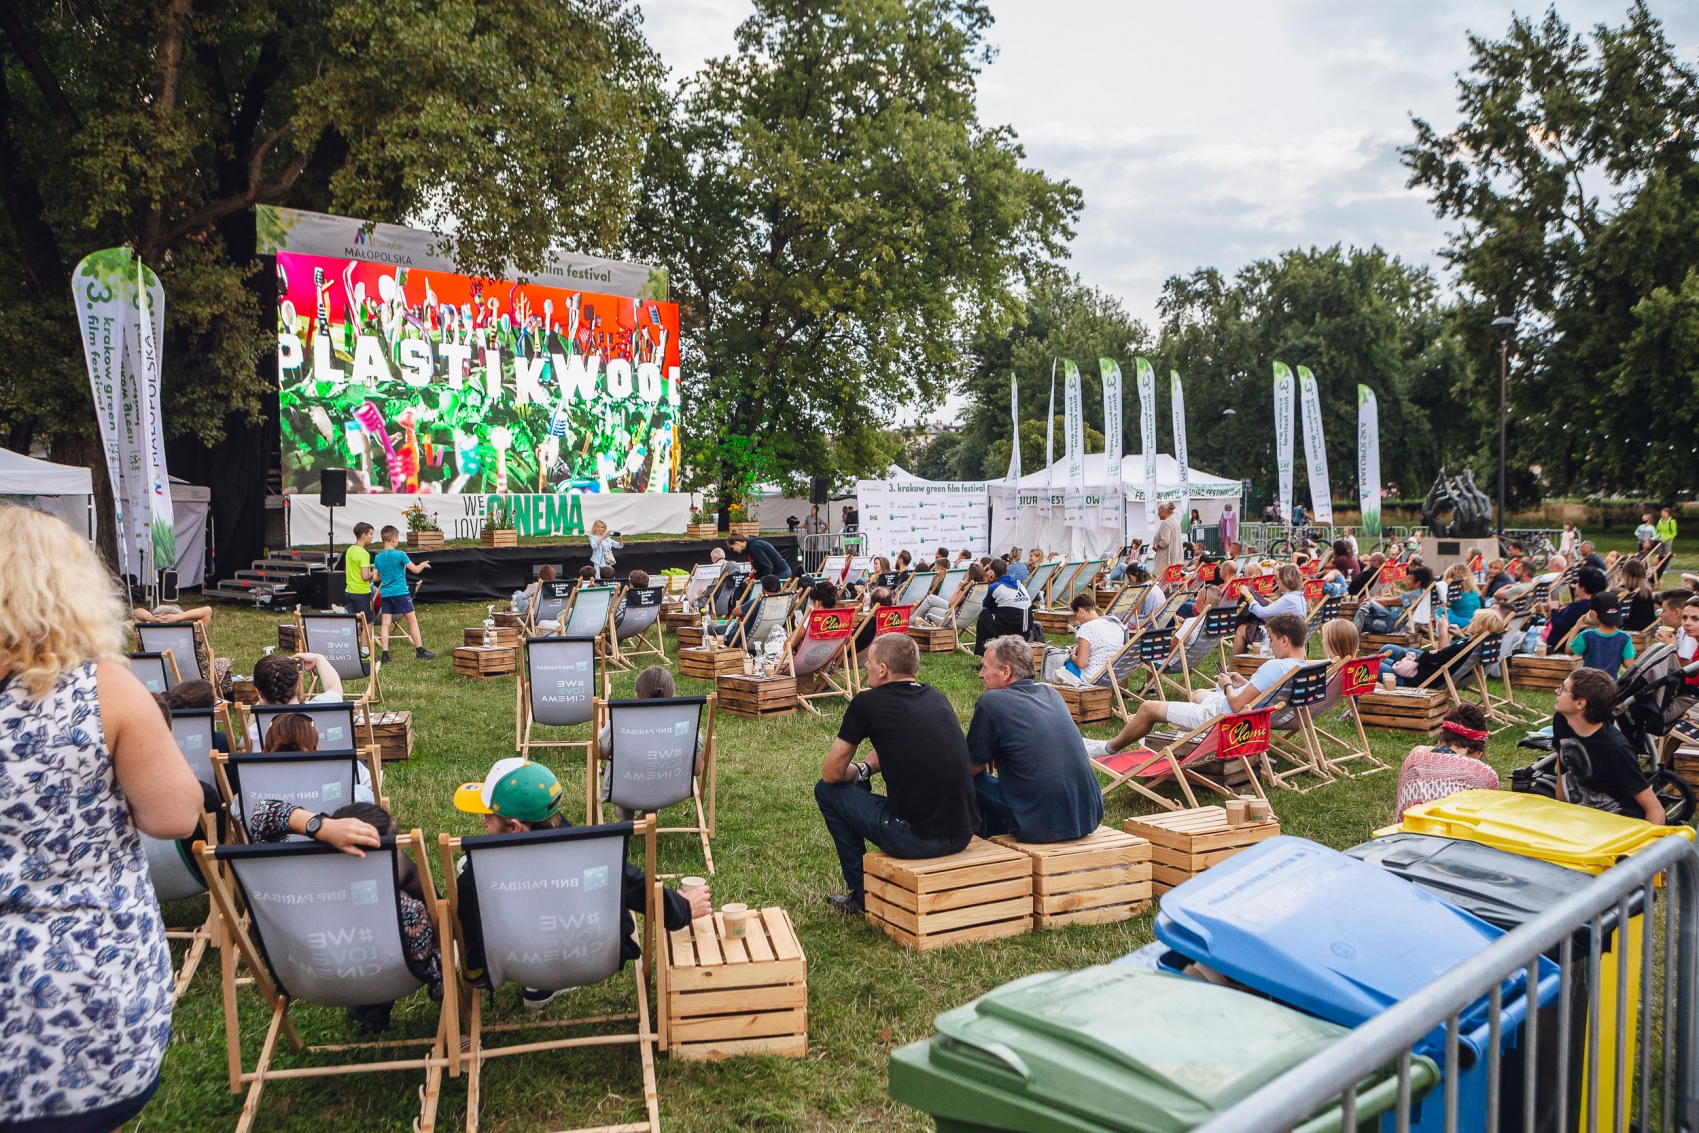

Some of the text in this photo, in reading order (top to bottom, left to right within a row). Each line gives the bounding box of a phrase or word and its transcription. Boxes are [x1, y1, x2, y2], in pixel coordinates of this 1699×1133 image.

[344, 246, 413, 266] MAŁOPOLSKA
[566, 264, 611, 283] festival
[86, 281, 113, 310] 3.
[87, 314, 100, 346] film
[103, 317, 115, 382] krakow
[103, 384, 116, 431] green
[888, 483, 896, 493] 3.
[897, 483, 925, 493] krakow
[926, 486, 946, 495] green
[947, 483, 961, 493] film
[961, 483, 986, 493] festival
[463, 495, 485, 517] WE
[1229, 721, 1267, 745] Classic
